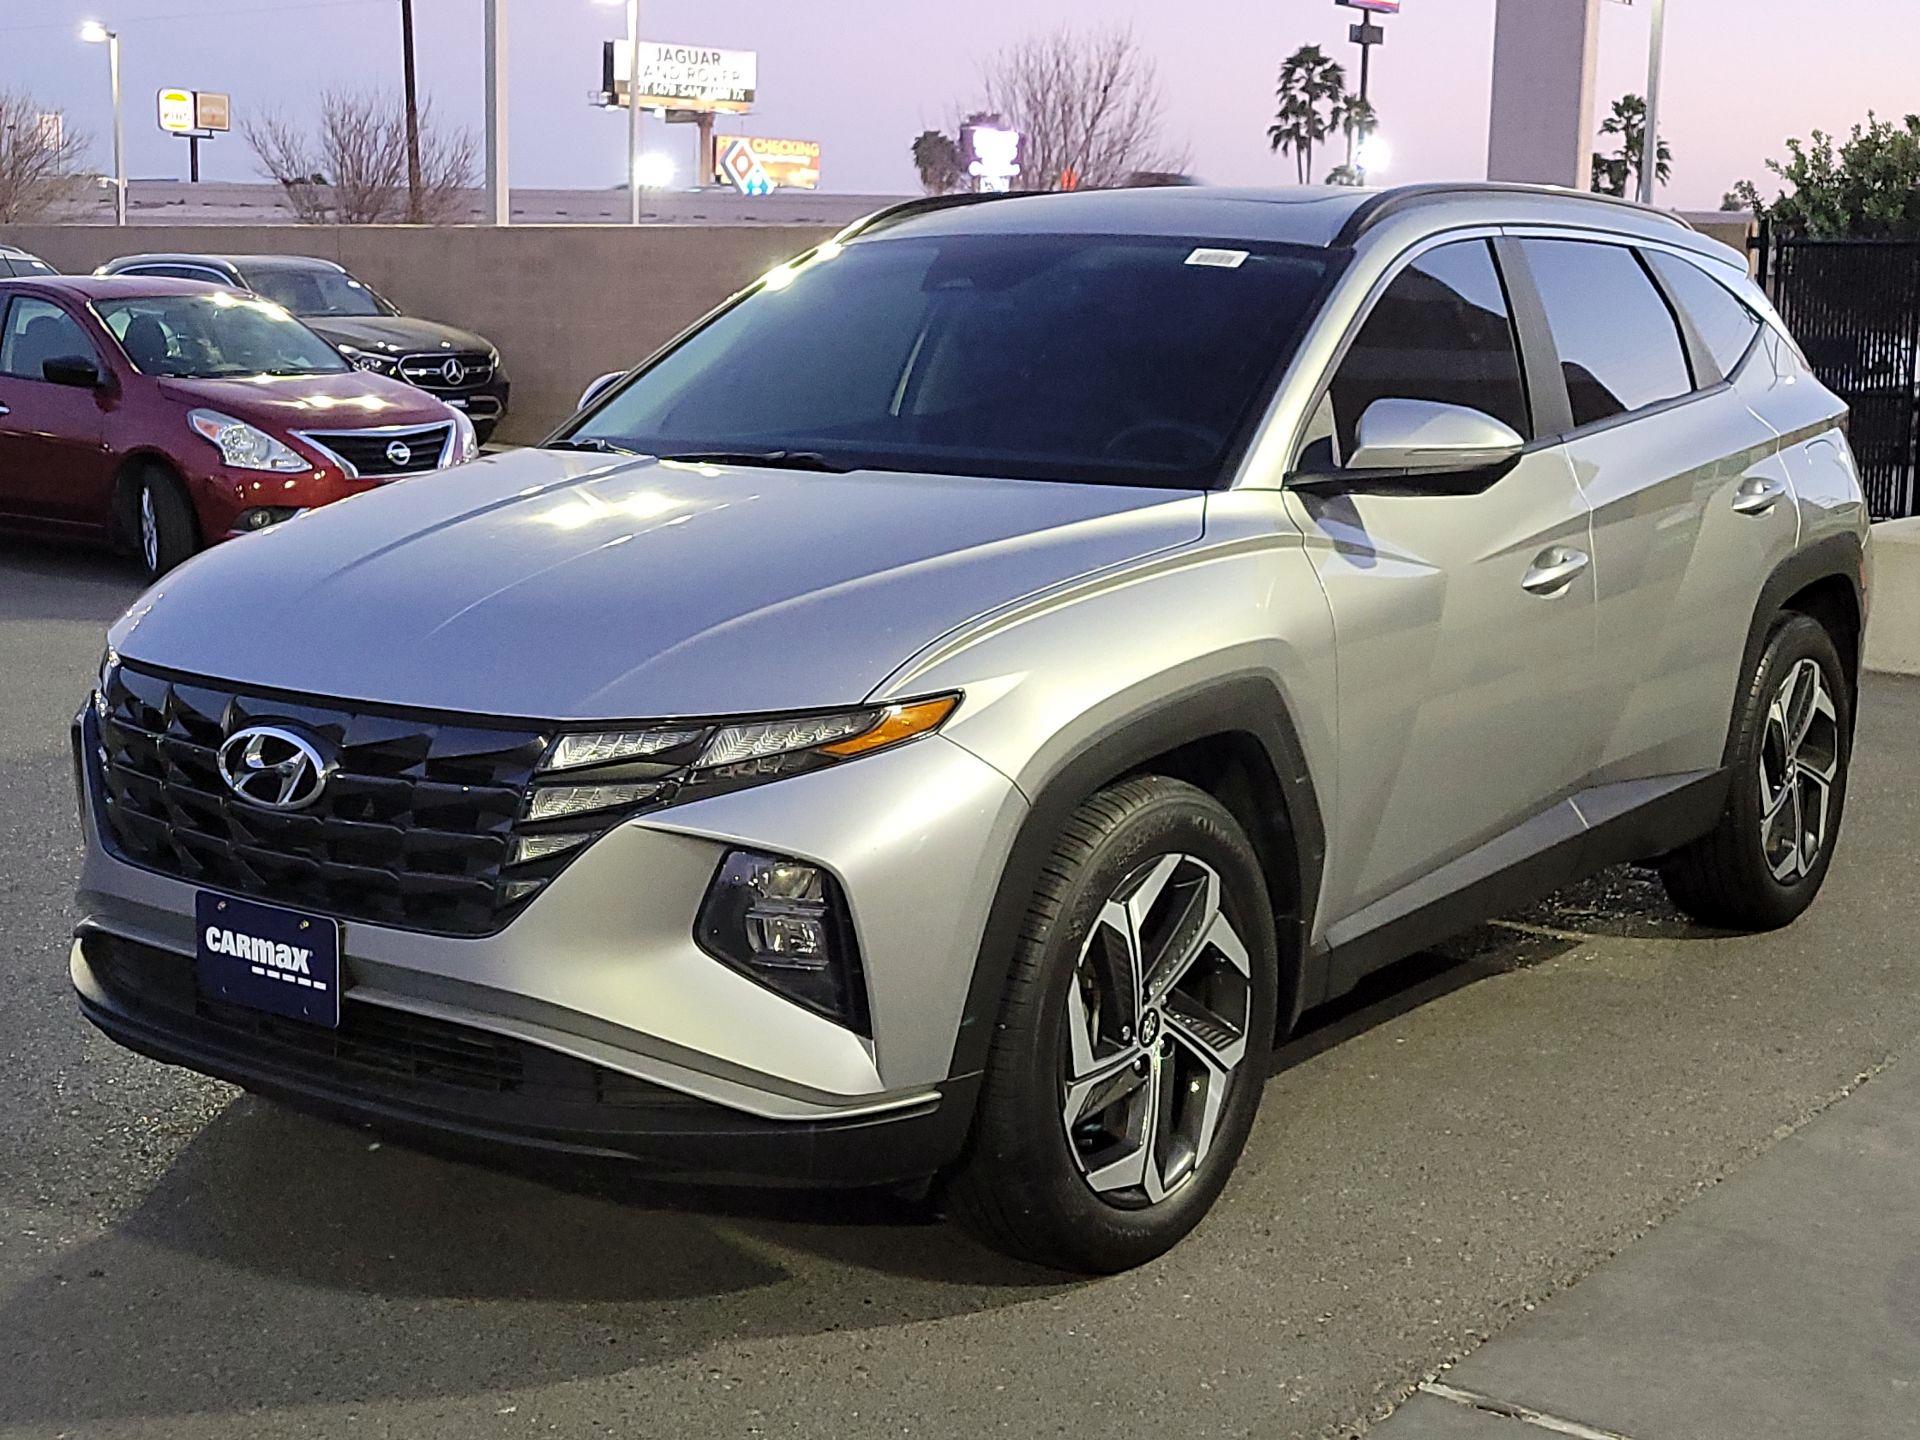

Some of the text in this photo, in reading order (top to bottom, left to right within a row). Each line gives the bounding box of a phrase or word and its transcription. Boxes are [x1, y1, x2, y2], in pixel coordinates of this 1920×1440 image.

[656, 47, 721, 65] JAGUAR
[641, 64, 741, 82] AND ROER
[752, 138, 820, 157] CHECKING
